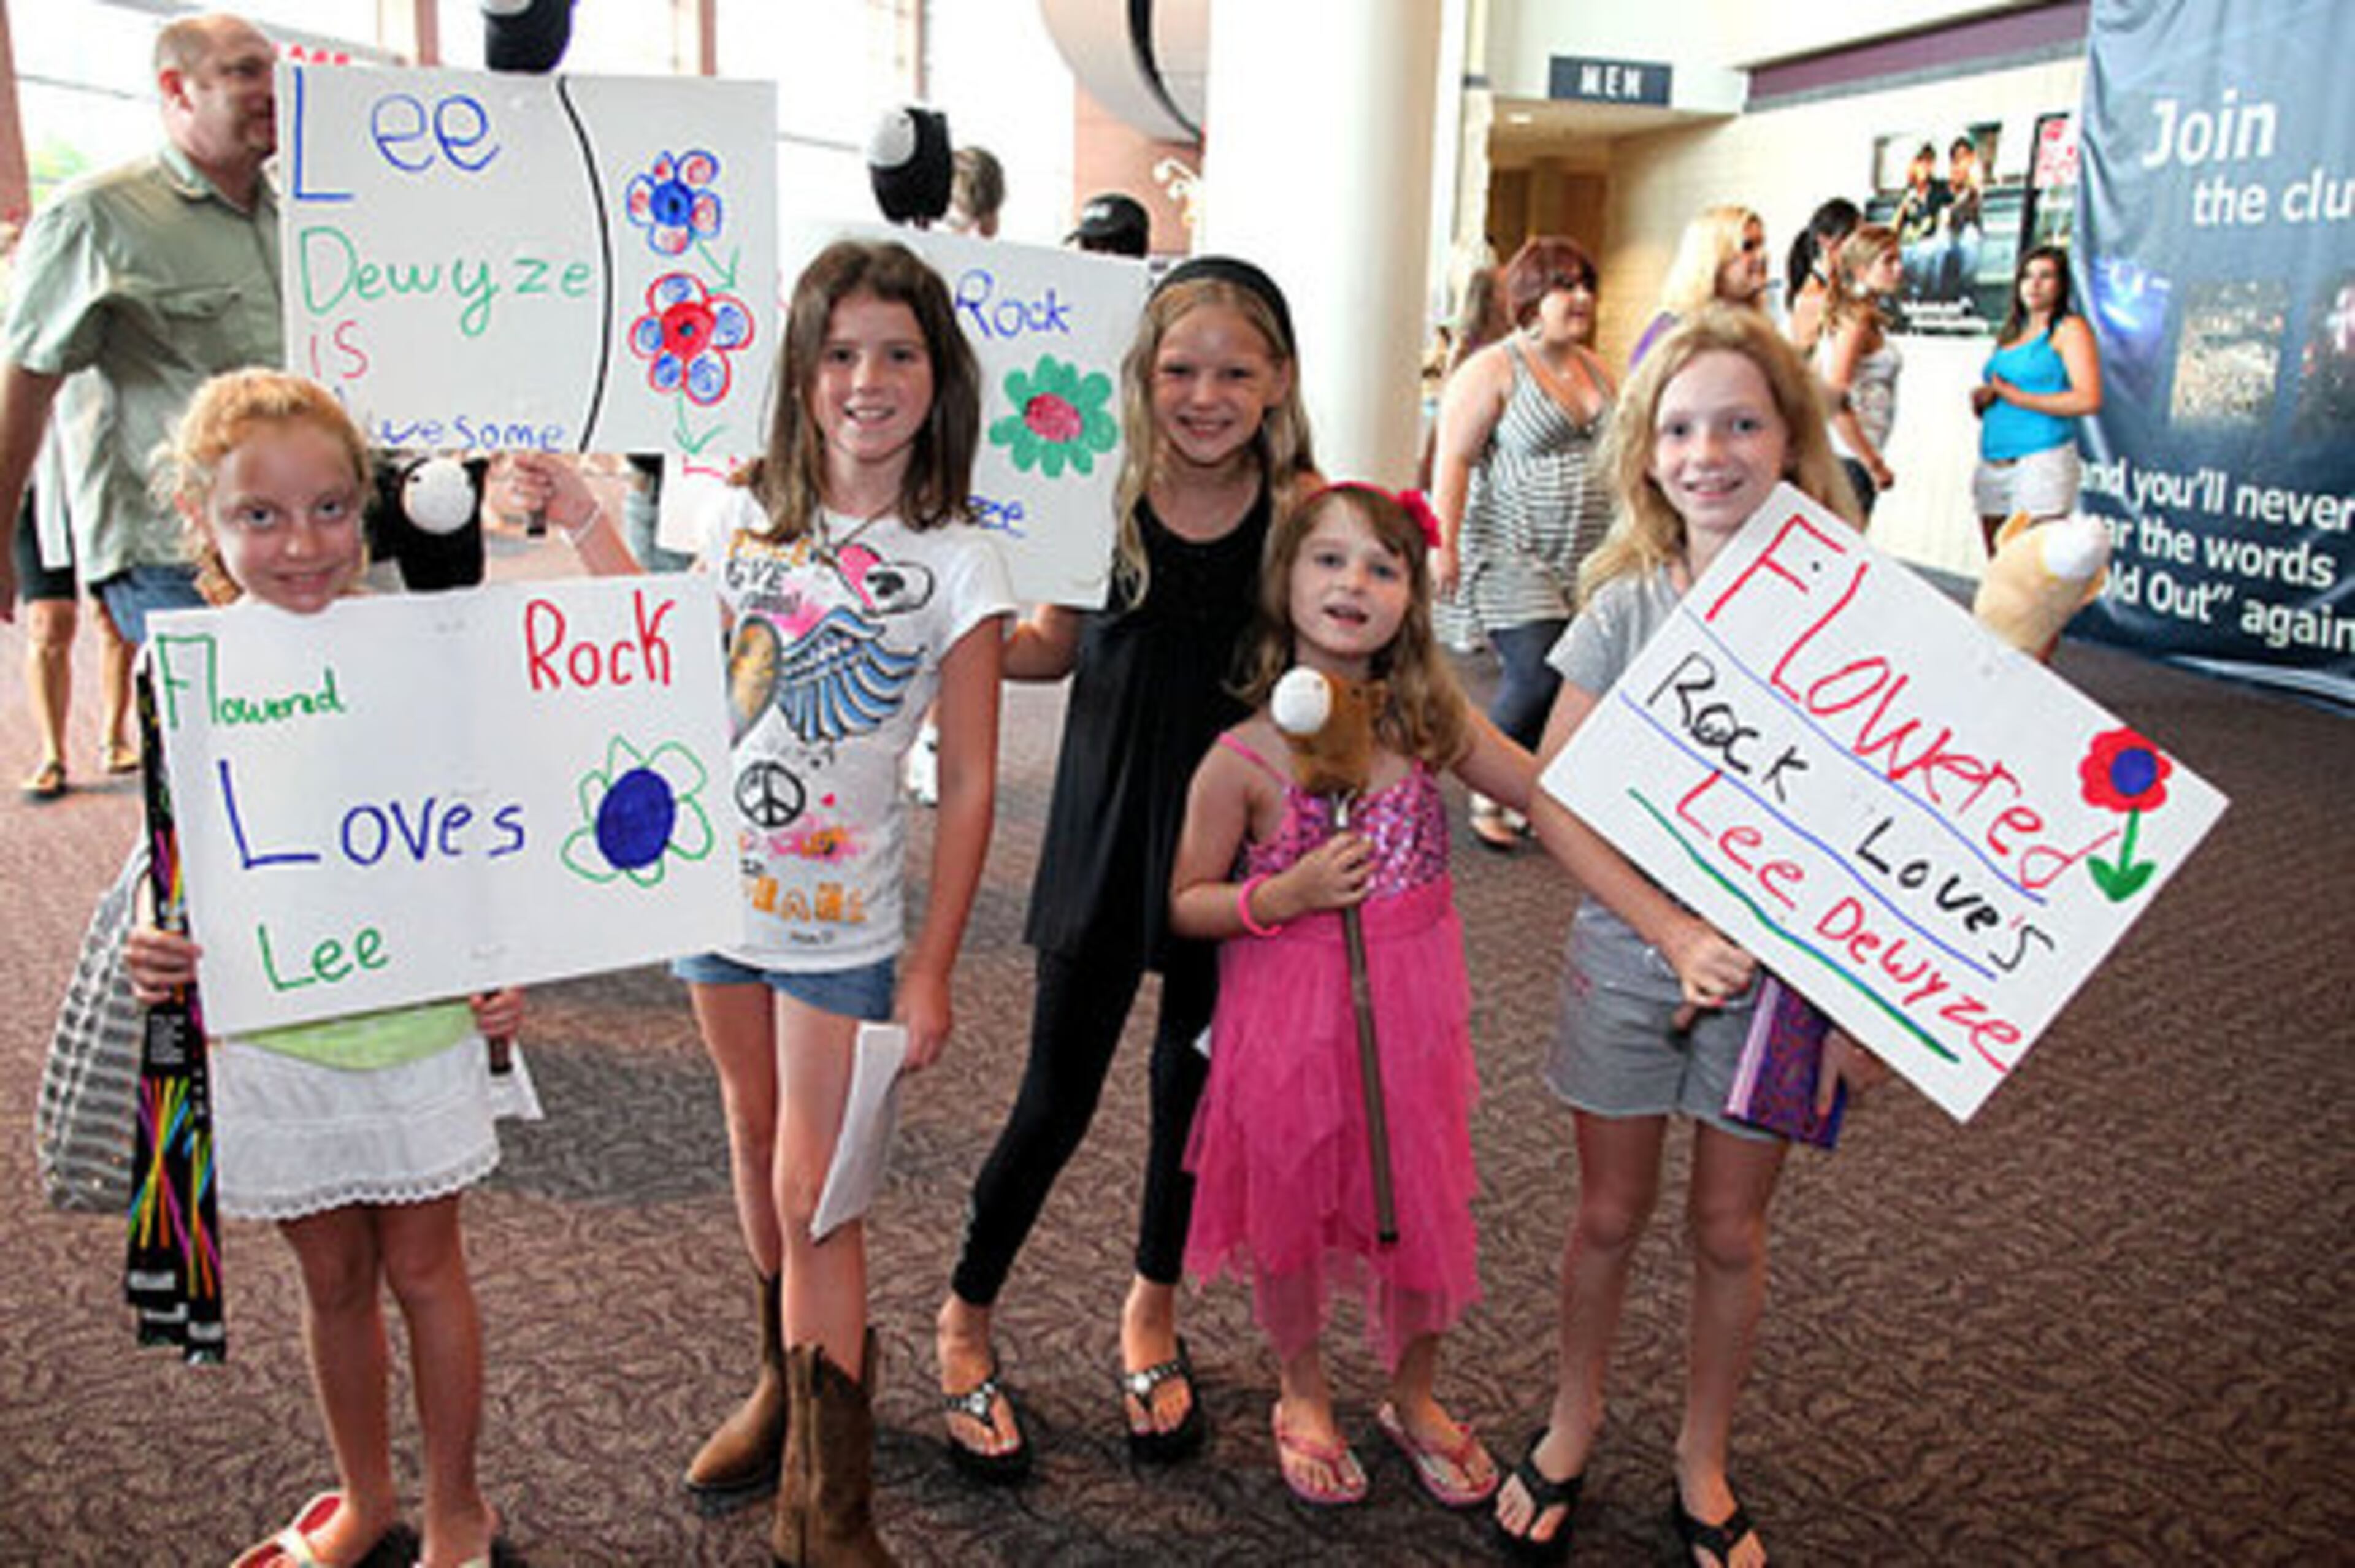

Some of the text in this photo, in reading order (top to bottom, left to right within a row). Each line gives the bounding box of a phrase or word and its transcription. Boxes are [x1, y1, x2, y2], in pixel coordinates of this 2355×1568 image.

[1580, 65, 1641, 99] MEN
[293, 66, 500, 200] Lee
[2142, 88, 2278, 168] Join
[2192, 167, 2355, 226] the clu
[299, 226, 591, 338] Dewyze
[955, 269, 1073, 338] Rock
[2133, 466, 2229, 516] you'll
[2235, 484, 2355, 532] never
[2139, 515, 2197, 564] the
[2204, 535, 2338, 590] words
[2240, 597, 2355, 650] again
[218, 759, 526, 870] Loves
[1675, 769, 1806, 911] Lee
[258, 924, 389, 991] Lee
